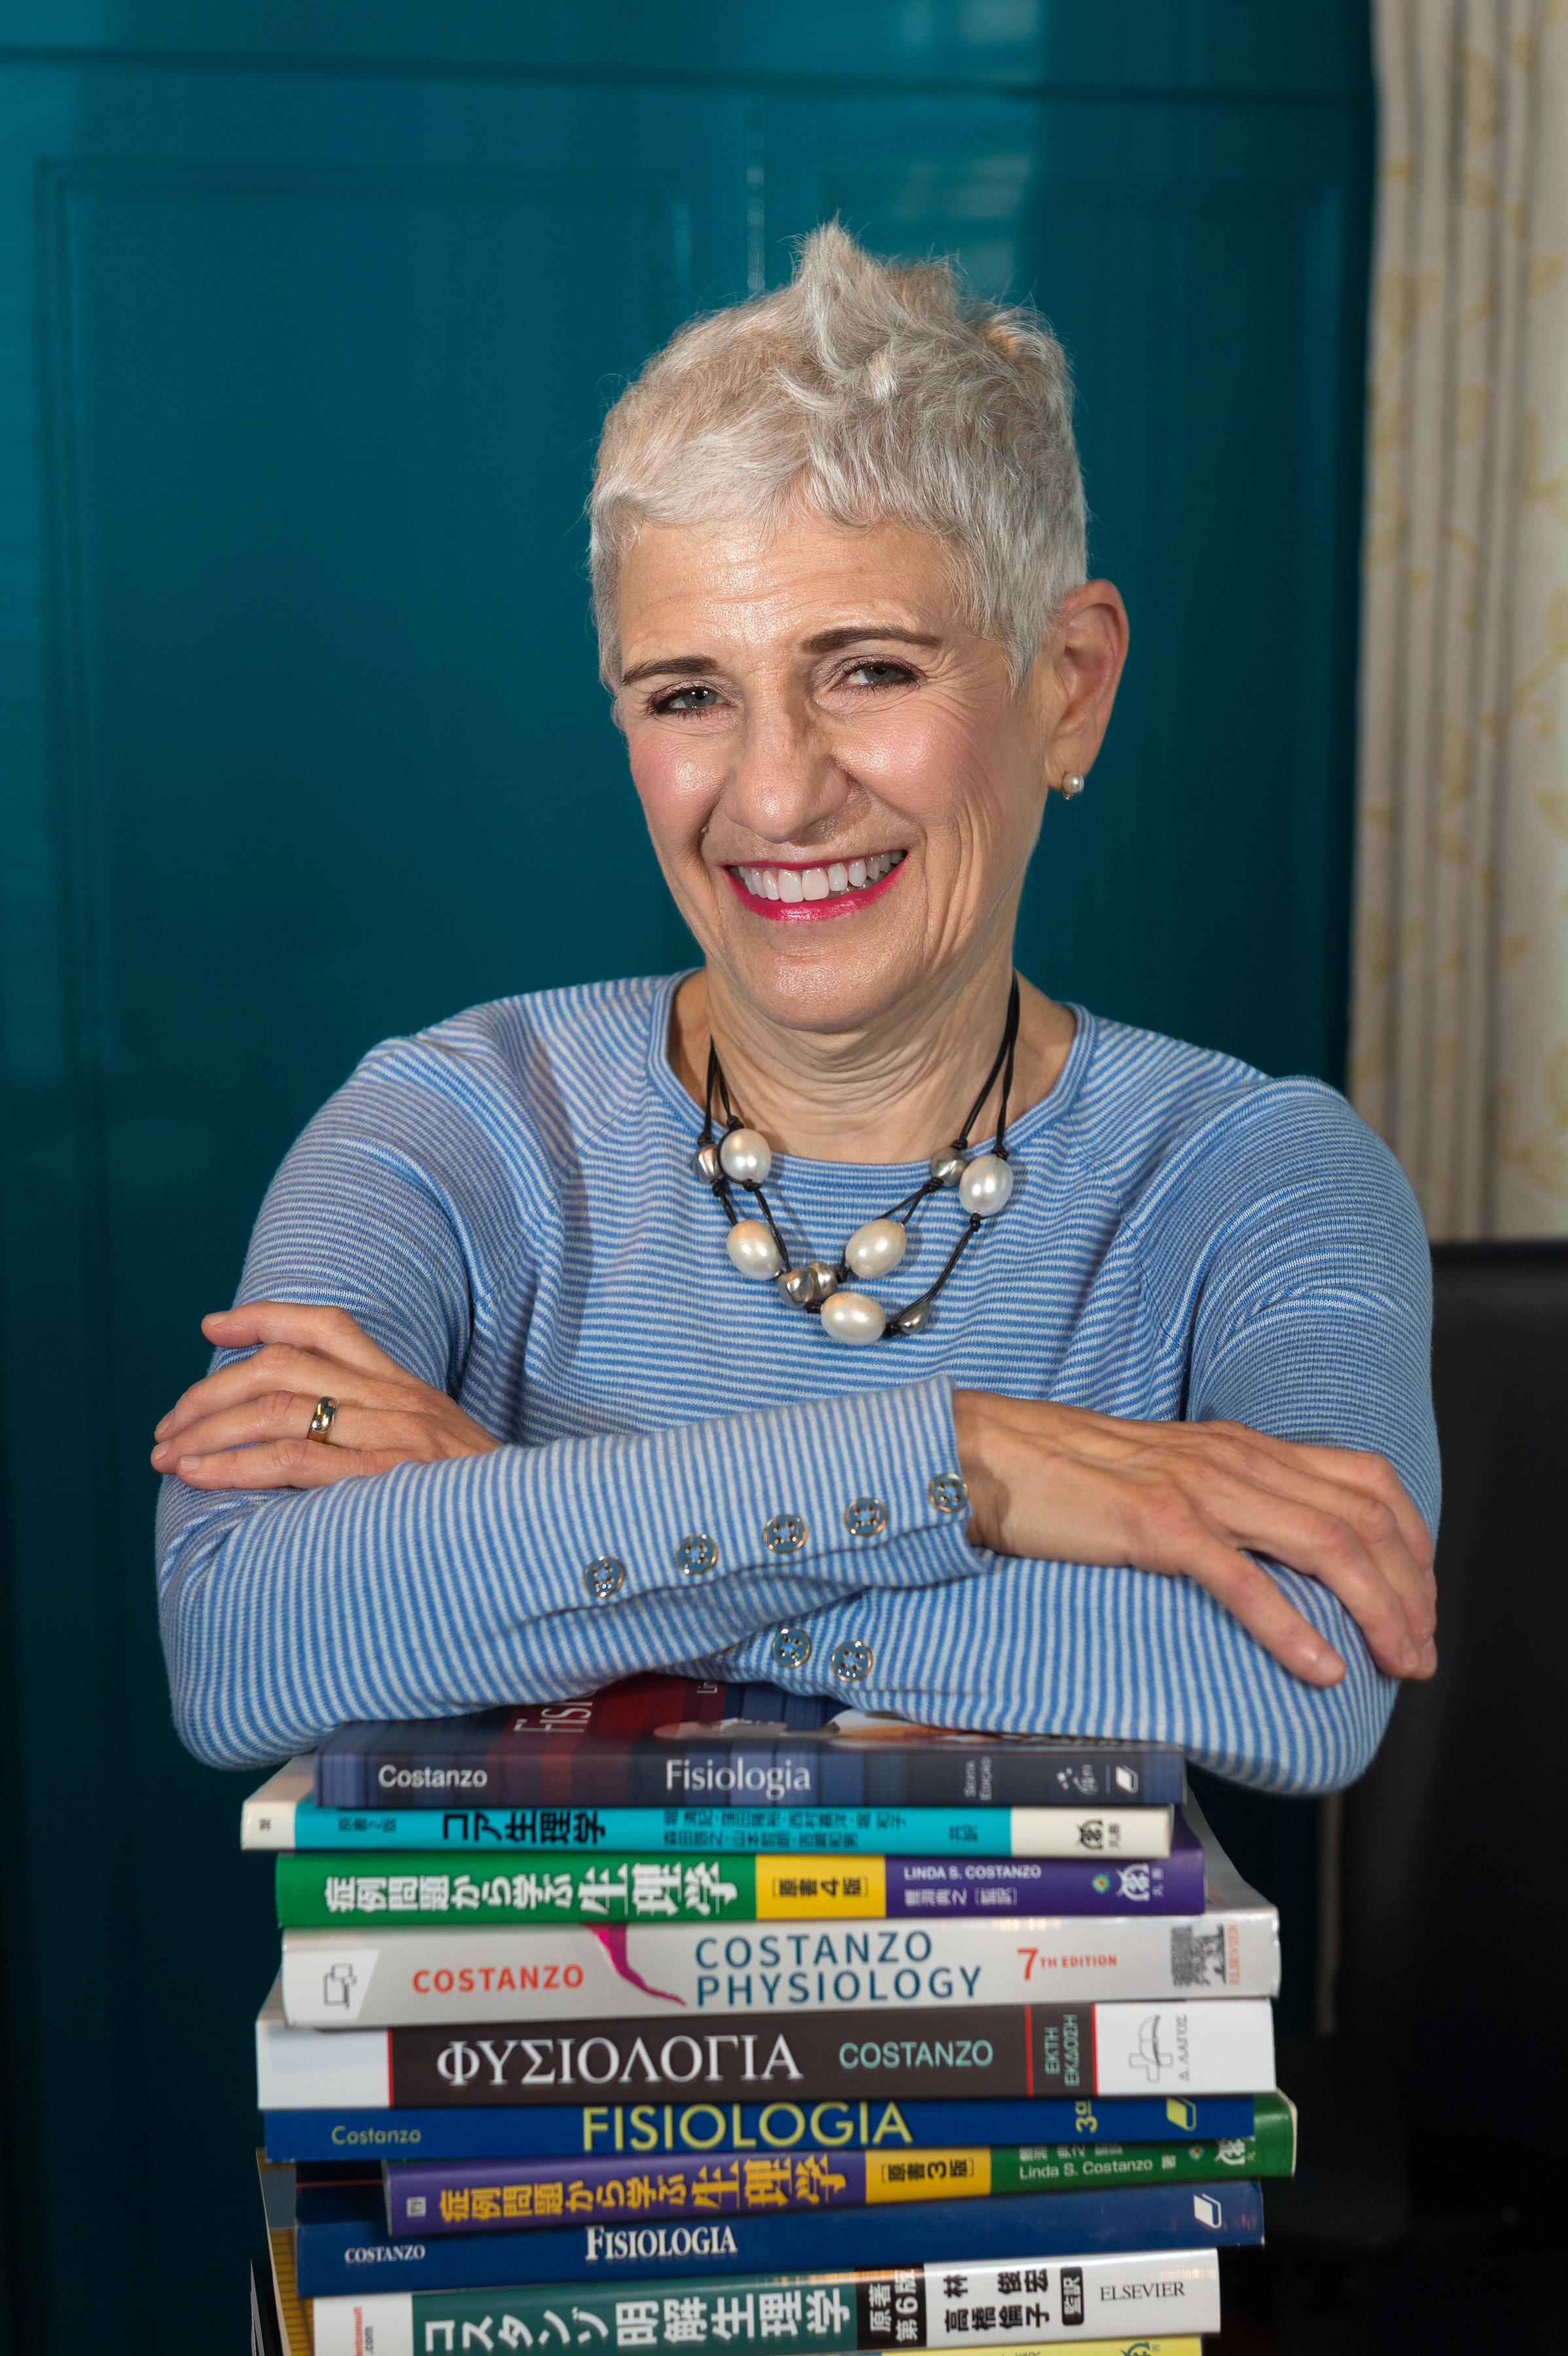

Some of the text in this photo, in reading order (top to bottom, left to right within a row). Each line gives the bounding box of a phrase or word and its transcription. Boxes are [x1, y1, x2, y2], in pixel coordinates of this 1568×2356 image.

[378, 1764, 488, 1789] Costanzo
[666, 1758, 811, 1800] Fisiologia
[443, 1811, 607, 1844] コア生理学
[325, 1863, 738, 1916] 症例問題から学ぶ生理学
[903, 1863, 1042, 1881] LINDA S. COSTANZO
[695, 1931, 932, 1969] COSTANZO
[1018, 1948, 1117, 1980] 7TH EDITION
[413, 1965, 584, 1993] COSTANZO
[697, 1965, 982, 2007] PHYSIOLOGY
[437, 2034, 802, 2086] ΦΥΣΙΟΛΟΓΙΑ
[839, 2039, 993, 2069] COSTANZO
[1045, 2026, 1061, 2075] ΕΚΤΗ
[1064, 2014, 1080, 2086] ΕΚΔΟΣΗ
[331, 2125, 421, 2145] Costanzo
[583, 2101, 913, 2151] FISIOLOGIA
[438, 2154, 847, 2222] 症例問題から学ぶ生理学
[1019, 2166, 1058, 2181] Linda
[1063, 2165, 1079, 2177] S.
[1082, 2160, 1153, 2175] Costanzo
[344, 2245, 426, 2263] COSTANZO
[585, 2225, 738, 2261] FISIOLOGIA
[942, 2274, 969, 2298] 林
[1100, 2281, 1186, 2302] ELSEVIER
[426, 2287, 850, 2351] コスタンゾ明解生理学
[869, 2283, 893, 2333] 原著
[895, 2268, 921, 2342] 第6版
